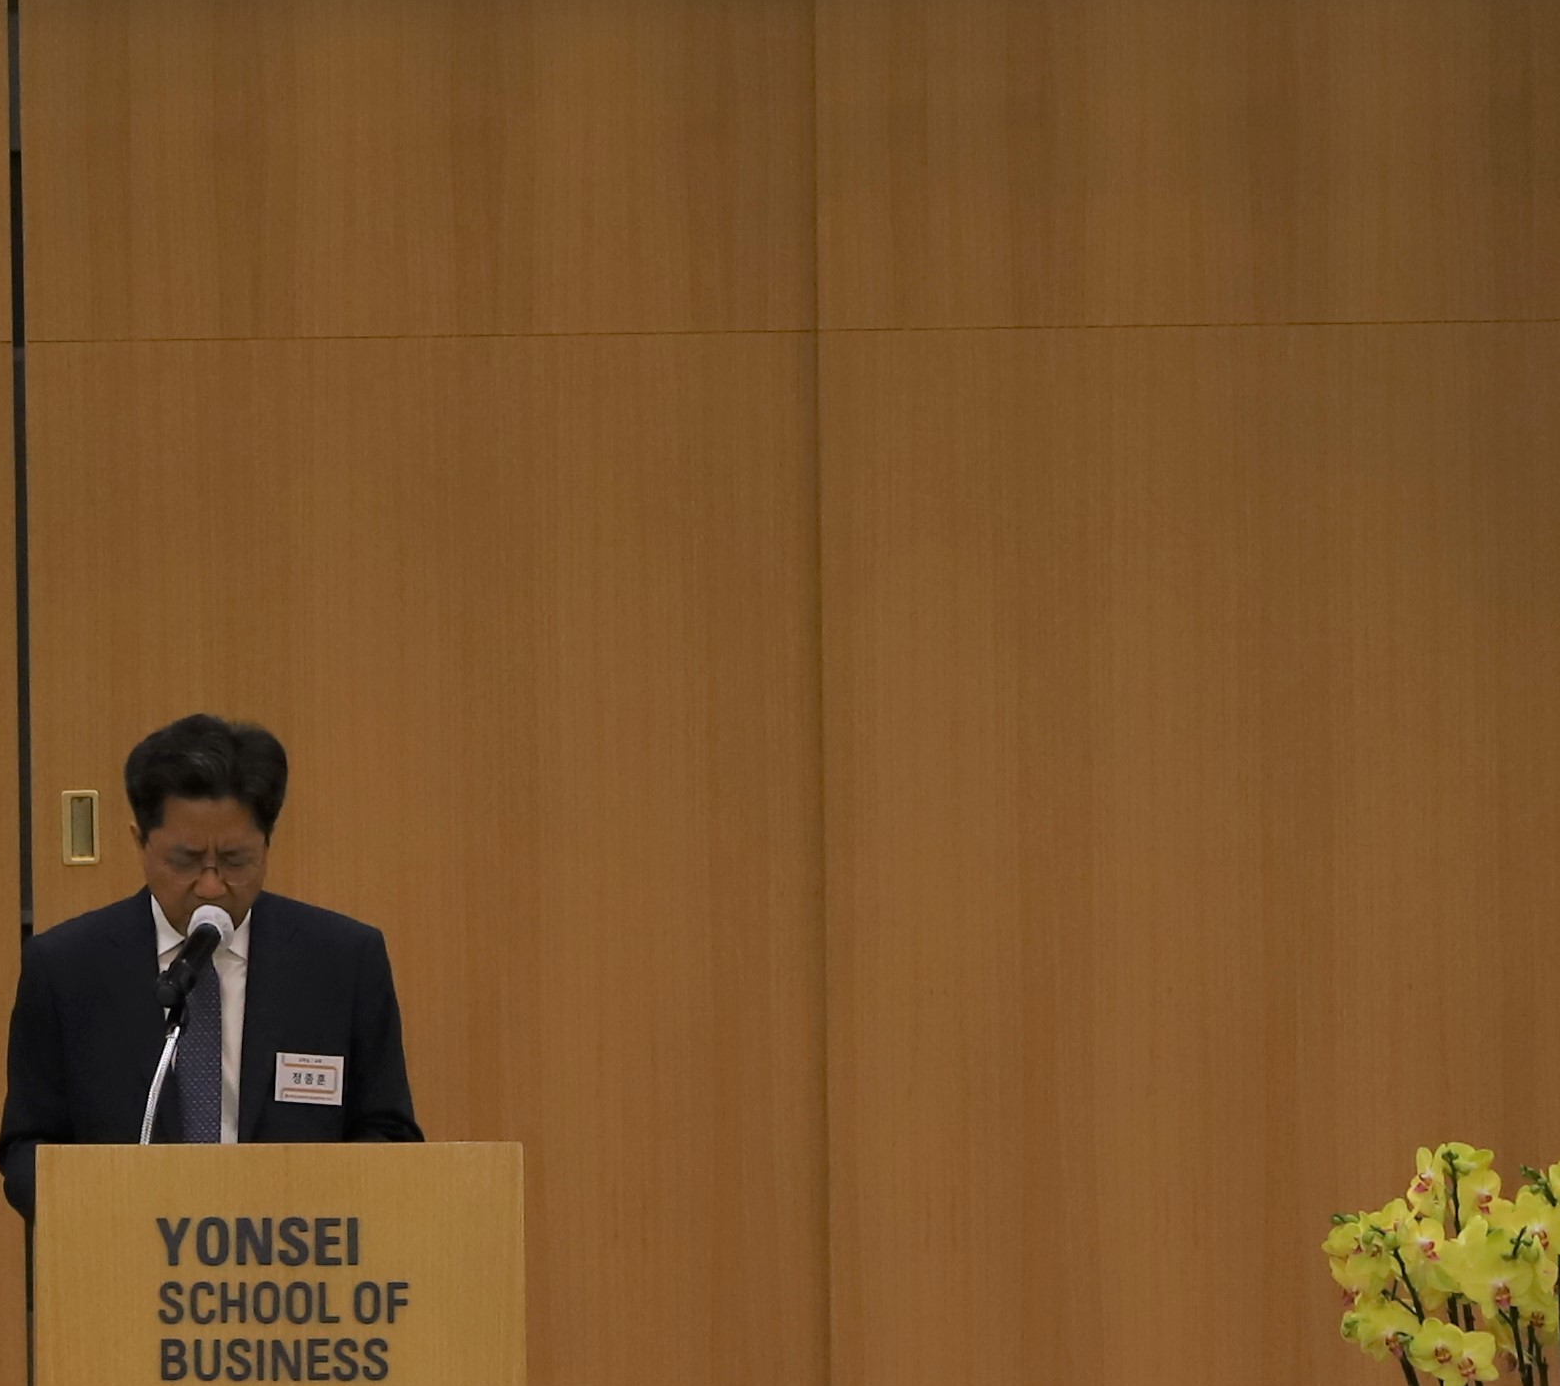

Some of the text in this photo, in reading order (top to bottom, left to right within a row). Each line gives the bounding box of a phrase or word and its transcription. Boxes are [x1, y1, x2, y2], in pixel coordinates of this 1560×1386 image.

[157, 1217, 358, 1267] YONSEI
[159, 1281, 408, 1325] SCHOOL OF
[161, 1338, 388, 1381] BUSINESS
